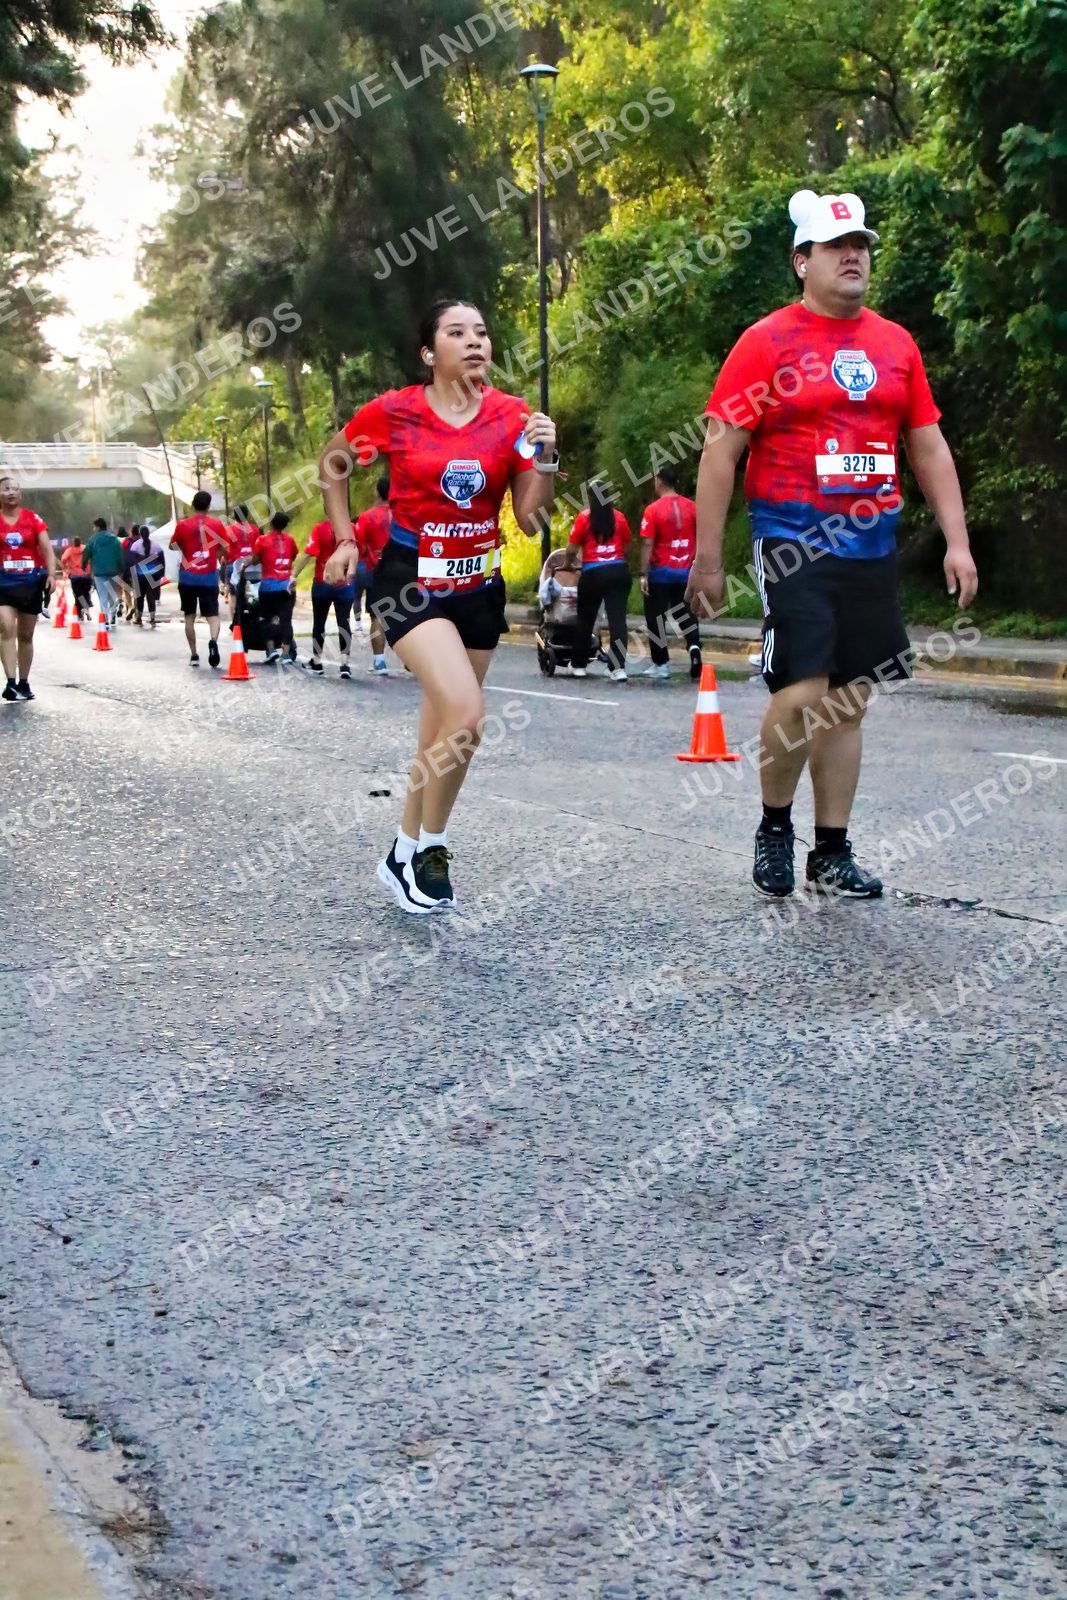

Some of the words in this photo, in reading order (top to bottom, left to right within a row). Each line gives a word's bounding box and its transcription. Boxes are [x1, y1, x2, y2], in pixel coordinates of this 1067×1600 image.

[831, 202, 852, 220] B
[843, 455, 876, 473] 3279
[446, 556, 482, 577] 2484
